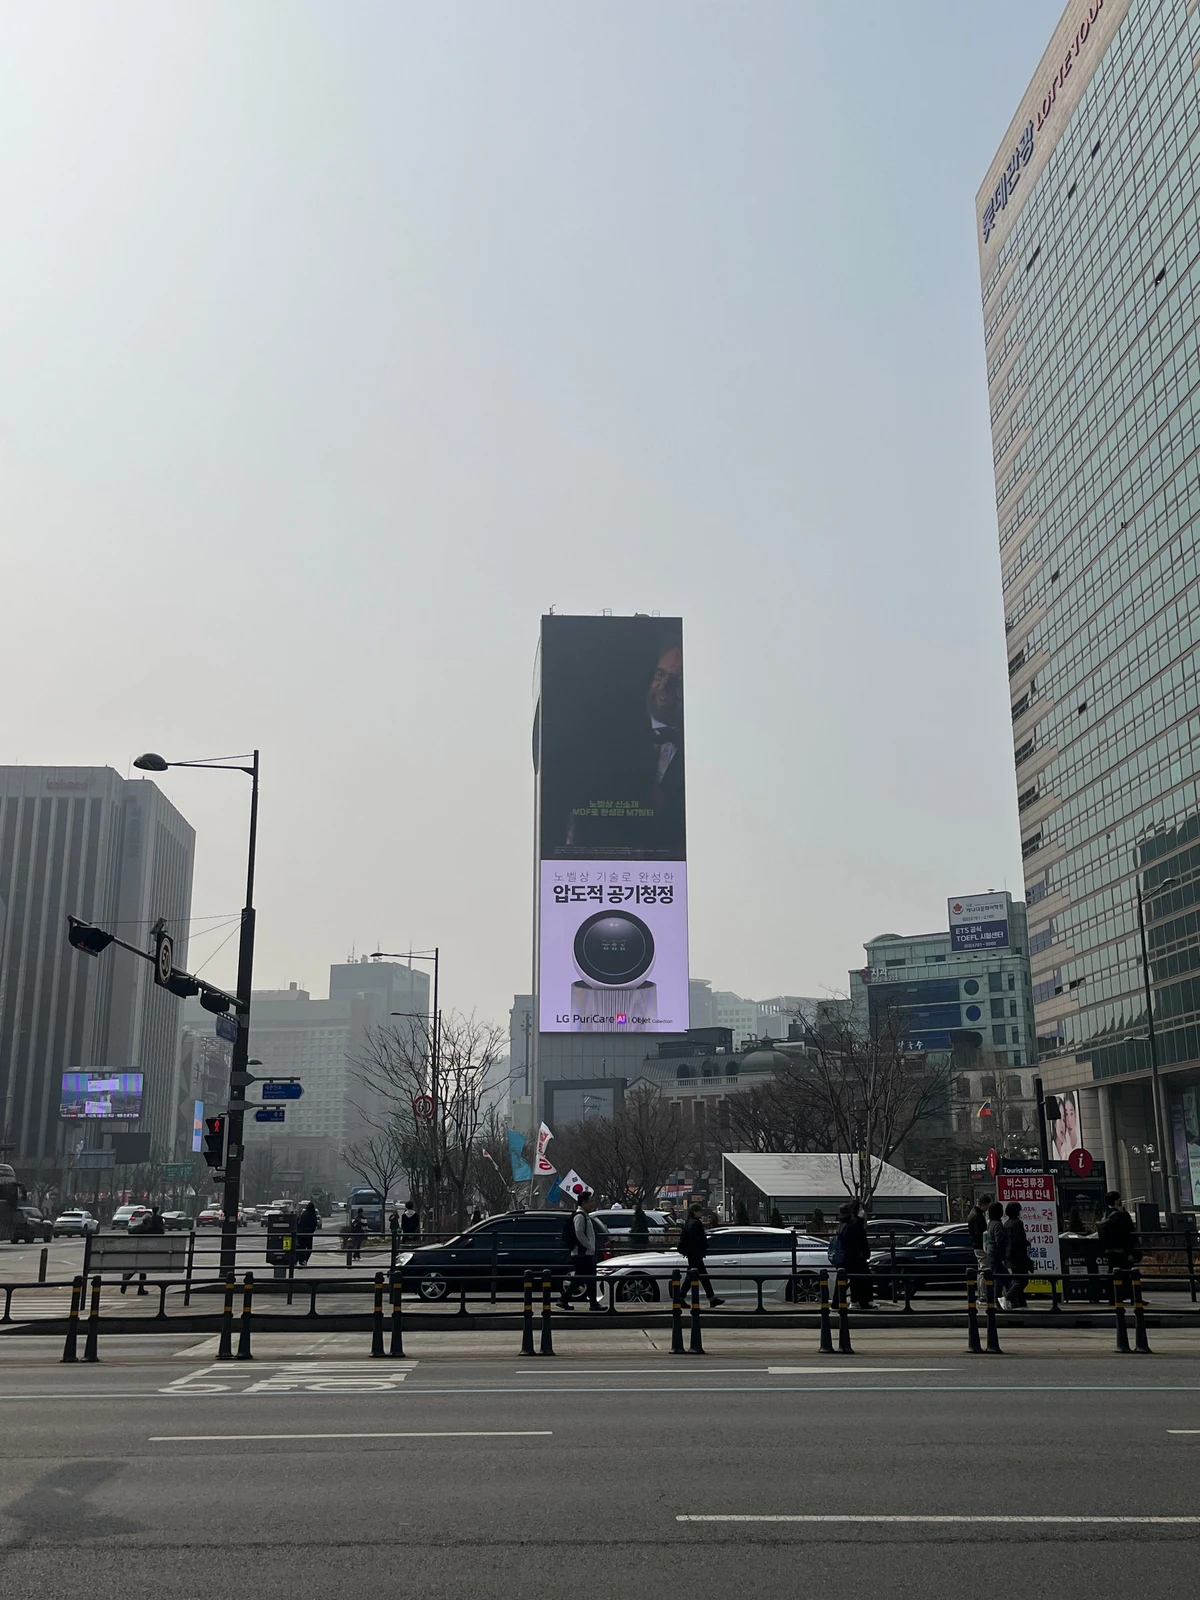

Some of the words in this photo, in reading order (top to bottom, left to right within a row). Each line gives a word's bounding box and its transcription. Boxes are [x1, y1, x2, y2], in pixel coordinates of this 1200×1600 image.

[982, 119, 1034, 244] 롯데관광
[1035, 50, 1073, 132] LOTTE
[589, 800, 613, 808] 노벨상
[572, 808, 599, 816] MOF로
[554, 871, 590, 882] 노벨상
[596, 871, 632, 882] 기술로
[638, 871, 674, 882] 완성한
[553, 884, 603, 904] 압도적
[607, 884, 674, 904] 공기청정
[955, 927, 970, 935] ETS
[956, 934, 980, 942] TOEFL
[871, 967, 888, 977] 치과
[556, 1014, 570, 1023] LG
[573, 1014, 615, 1023] PuriCare
[617, 1015, 626, 1023] AI
[631, 1016, 651, 1025] Objet
[1006, 1177, 1044, 1188] 버스정류장
[1003, 1189, 1033, 1200] 임시폐쇄
[1035, 1189, 1051, 1200] 안내
